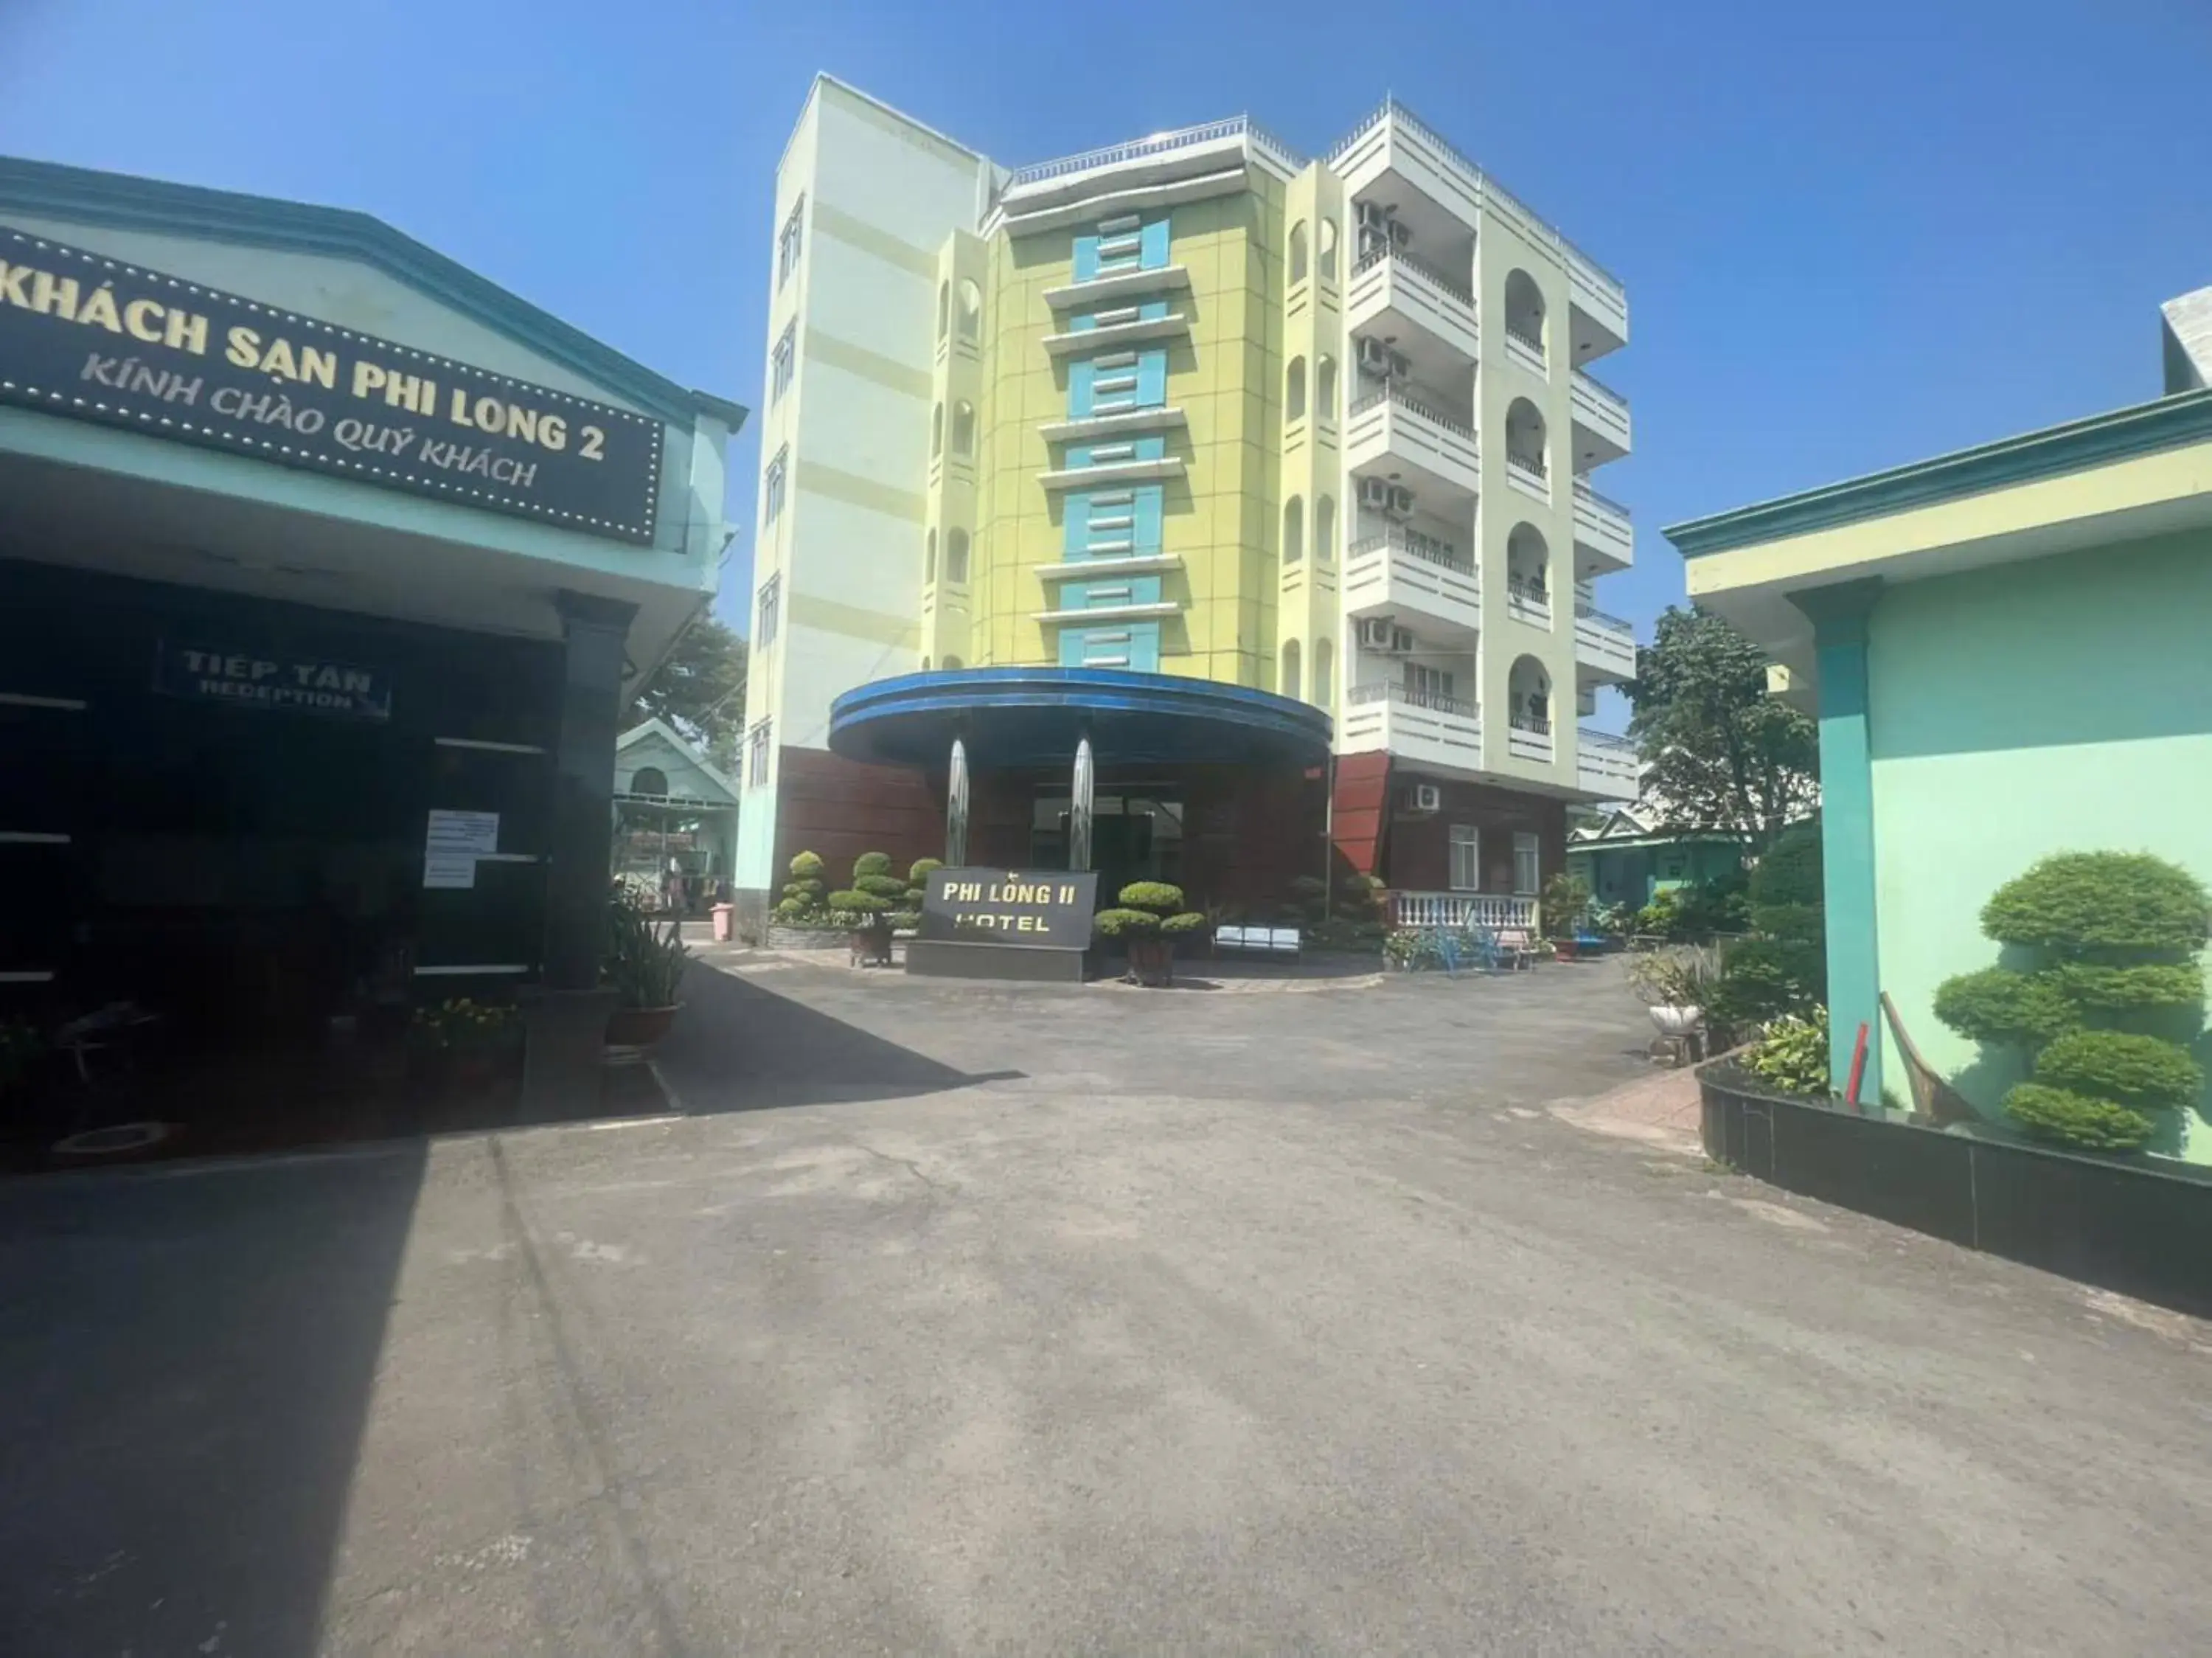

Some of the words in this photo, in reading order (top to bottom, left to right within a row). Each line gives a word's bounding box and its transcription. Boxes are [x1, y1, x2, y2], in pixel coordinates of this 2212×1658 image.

[0, 260, 208, 355] KHÁCH
[225, 326, 337, 389] SẠN
[352, 361, 437, 417] PHI
[451, 388, 567, 451] LONG
[579, 426, 605, 461] 2
[80, 352, 204, 406] KÍNH
[210, 387, 325, 434] CHÀO
[333, 418, 417, 456] QUÝ
[419, 437, 538, 488] KHÁCH
[943, 882, 981, 902] PHI
